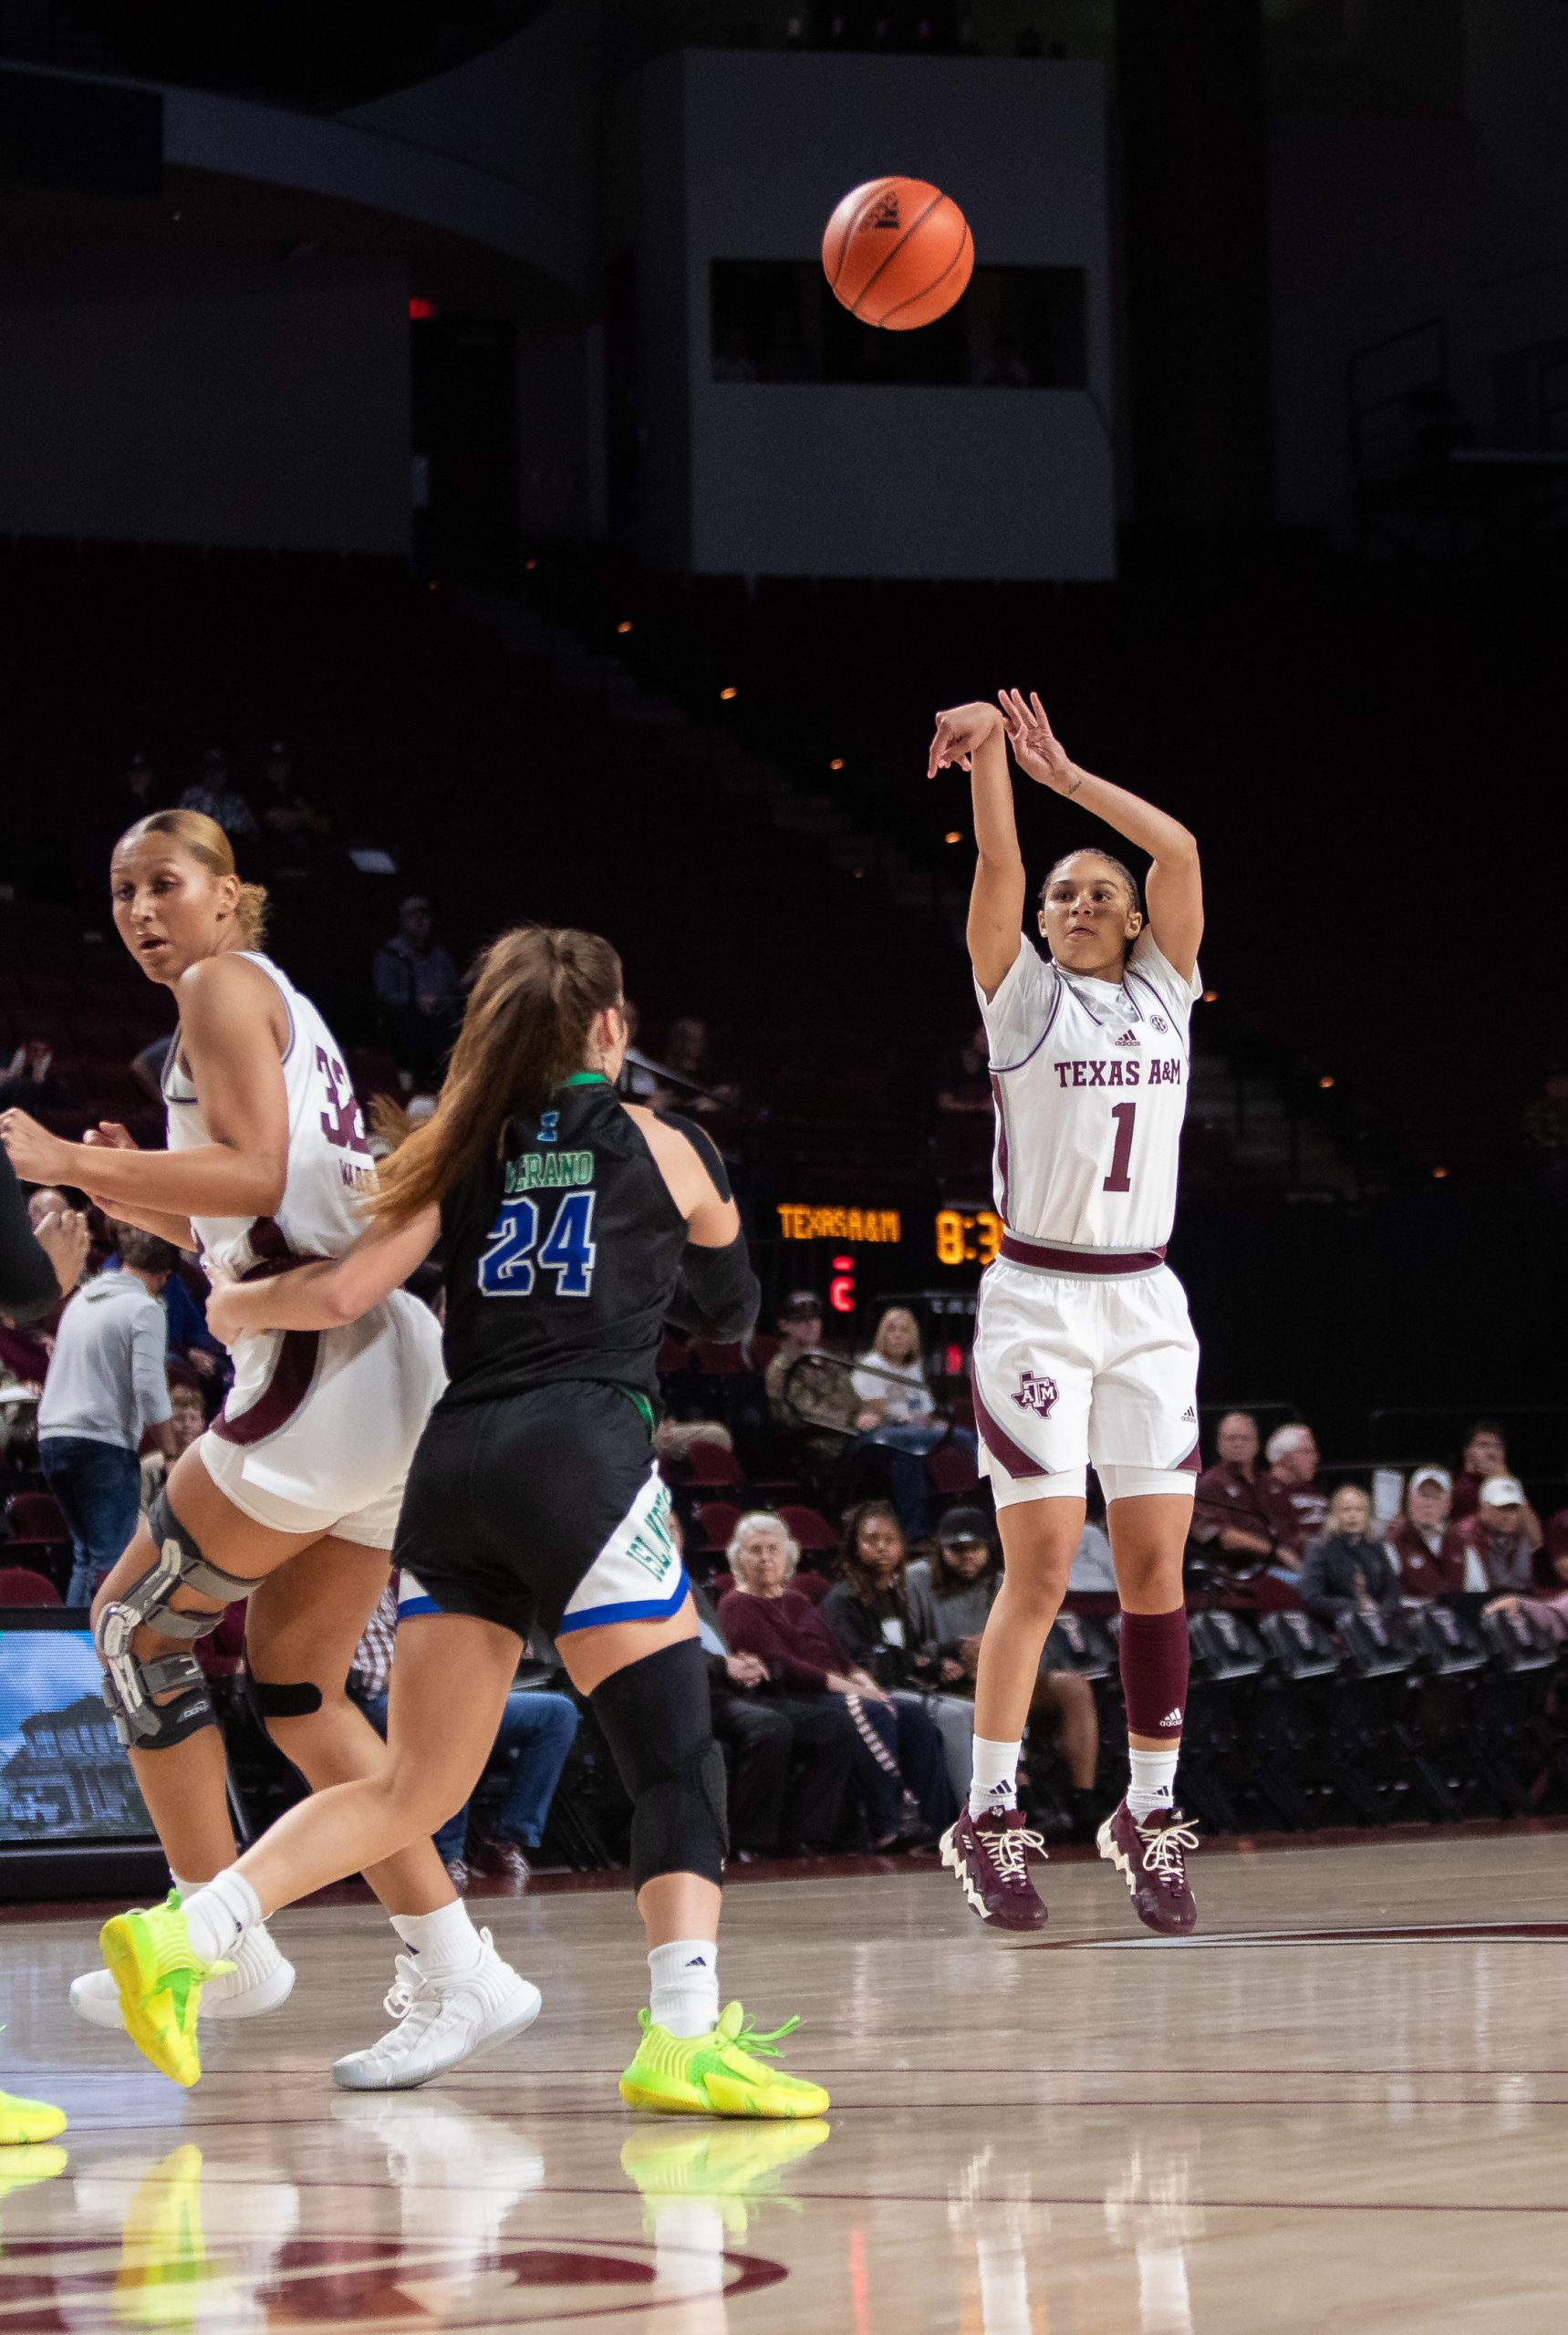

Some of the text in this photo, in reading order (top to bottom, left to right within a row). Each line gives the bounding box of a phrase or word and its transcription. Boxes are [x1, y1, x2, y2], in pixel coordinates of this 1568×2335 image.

[1054, 1058, 1180, 1087] TEXAS A&M
[1103, 1102, 1137, 1192] 1
[477, 1190, 597, 1297] 24
